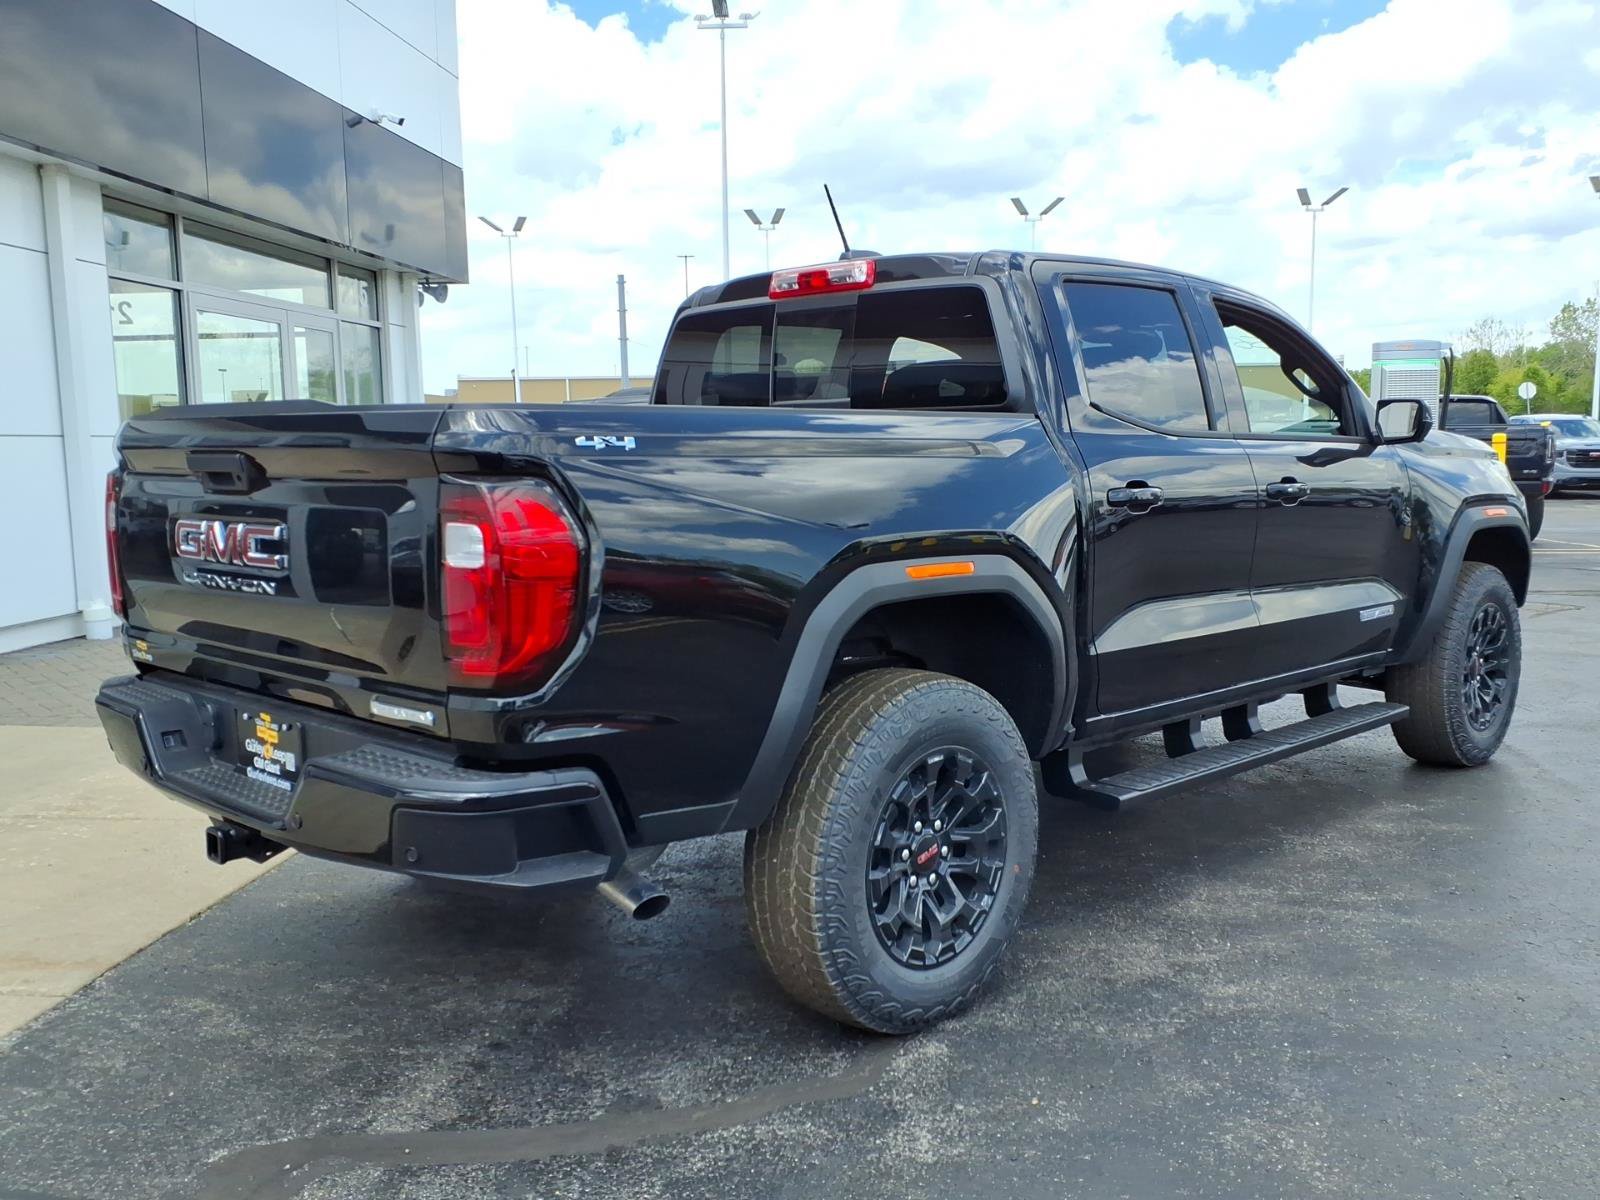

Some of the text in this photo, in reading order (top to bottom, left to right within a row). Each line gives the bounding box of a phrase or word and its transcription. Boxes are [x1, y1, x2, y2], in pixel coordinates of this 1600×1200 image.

[175, 519, 288, 569] GMC
[182, 571, 277, 595] CANYON
[917, 843, 939, 865] GMC
